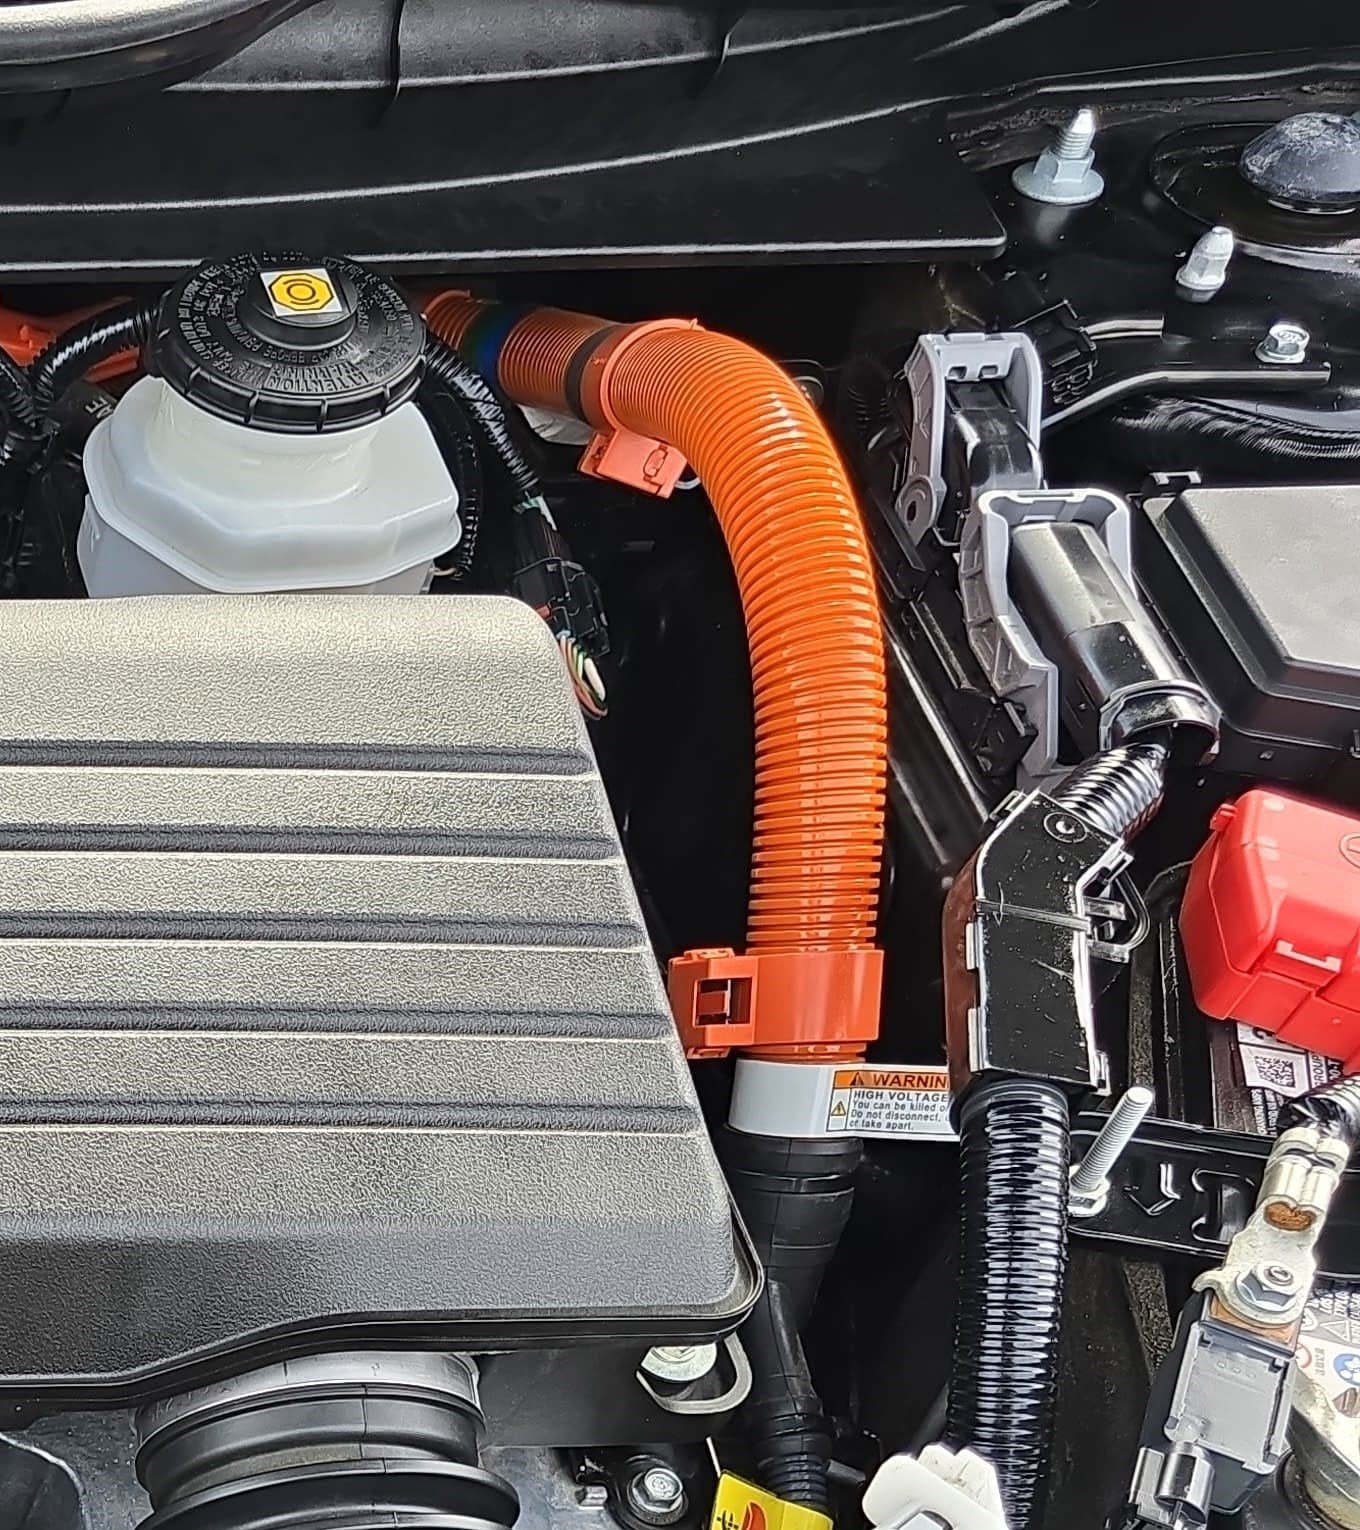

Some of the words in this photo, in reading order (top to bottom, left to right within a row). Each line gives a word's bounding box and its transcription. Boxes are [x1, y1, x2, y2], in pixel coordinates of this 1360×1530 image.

[873, 1073, 948, 1089] WARNIN
[853, 1090, 884, 1100] HIGH
[852, 1101, 869, 1109] You
[894, 1102, 906, 1110] be
[909, 1102, 936, 1112] killed
[851, 1109, 863, 1118] Do
[866, 1110, 882, 1119] not
[885, 1111, 941, 1123] disconnect,
[861, 1120, 882, 1128] take
[885, 1122, 914, 1131] apart.
